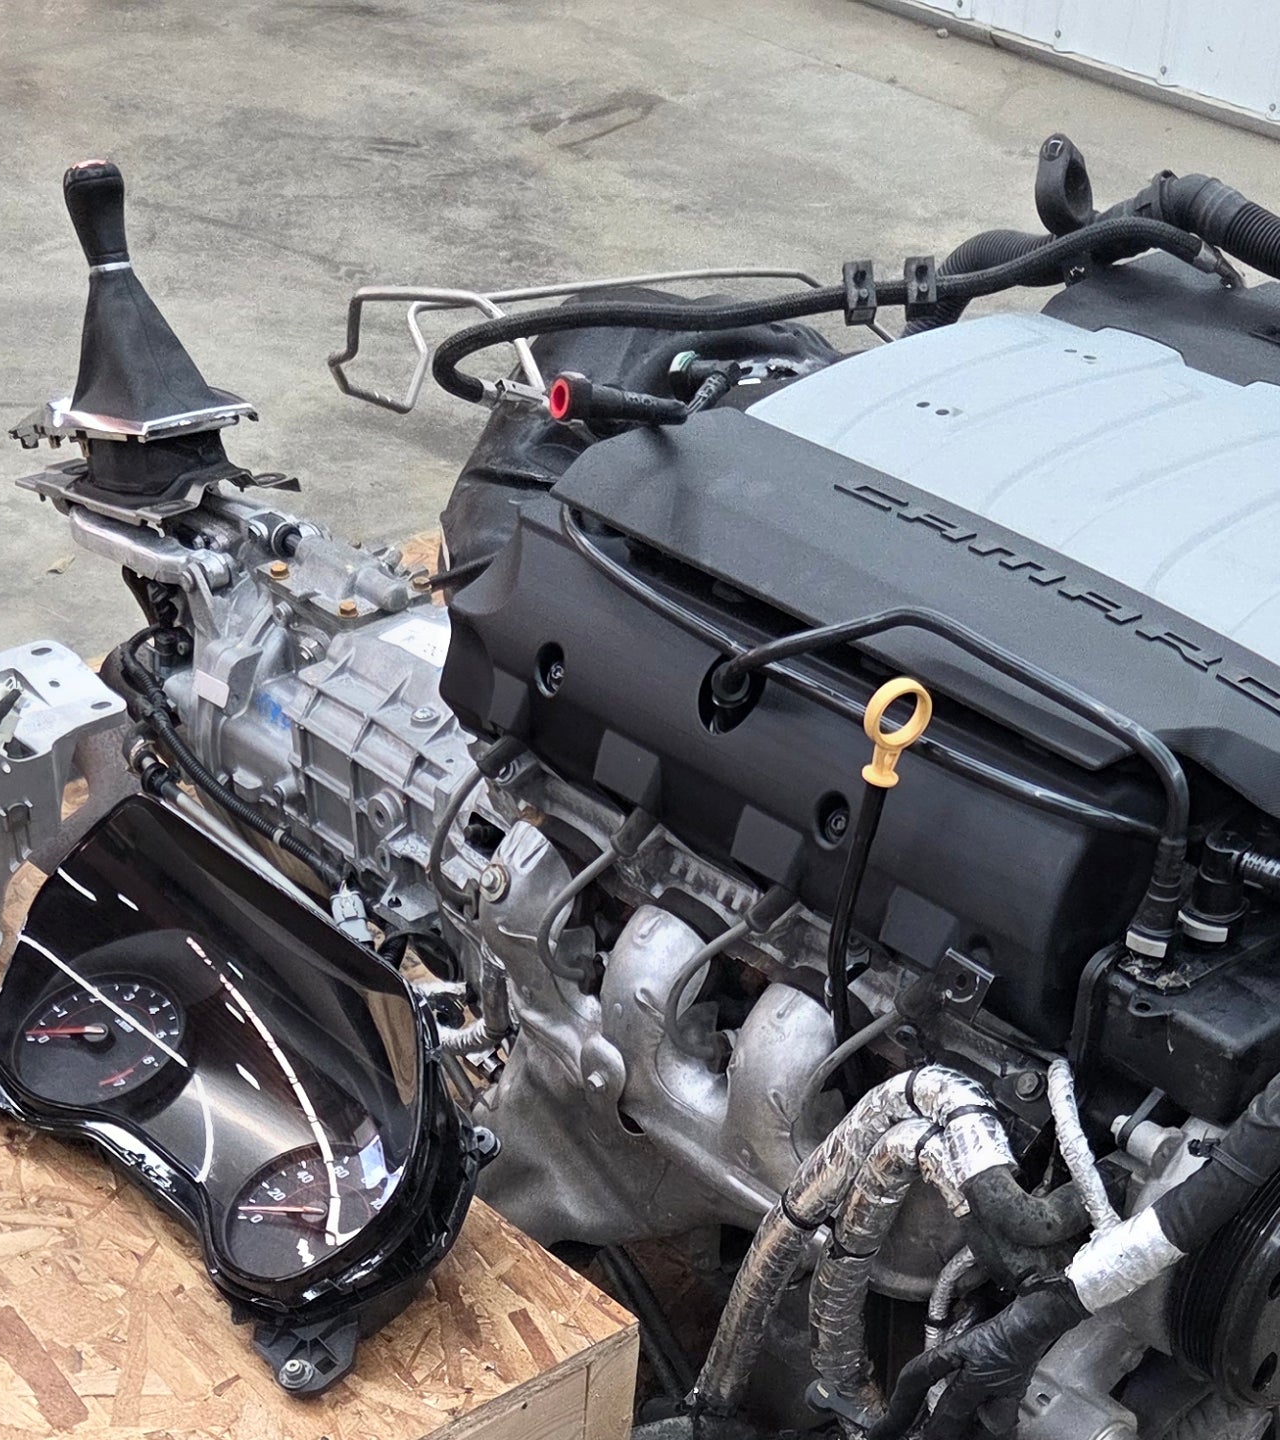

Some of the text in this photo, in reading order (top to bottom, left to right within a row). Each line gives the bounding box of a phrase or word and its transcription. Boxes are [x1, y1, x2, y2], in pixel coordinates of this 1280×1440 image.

[297, 1170, 314, 1184] 40
[267, 1187, 286, 1201] 20
[250, 1214, 263, 1224] 0
